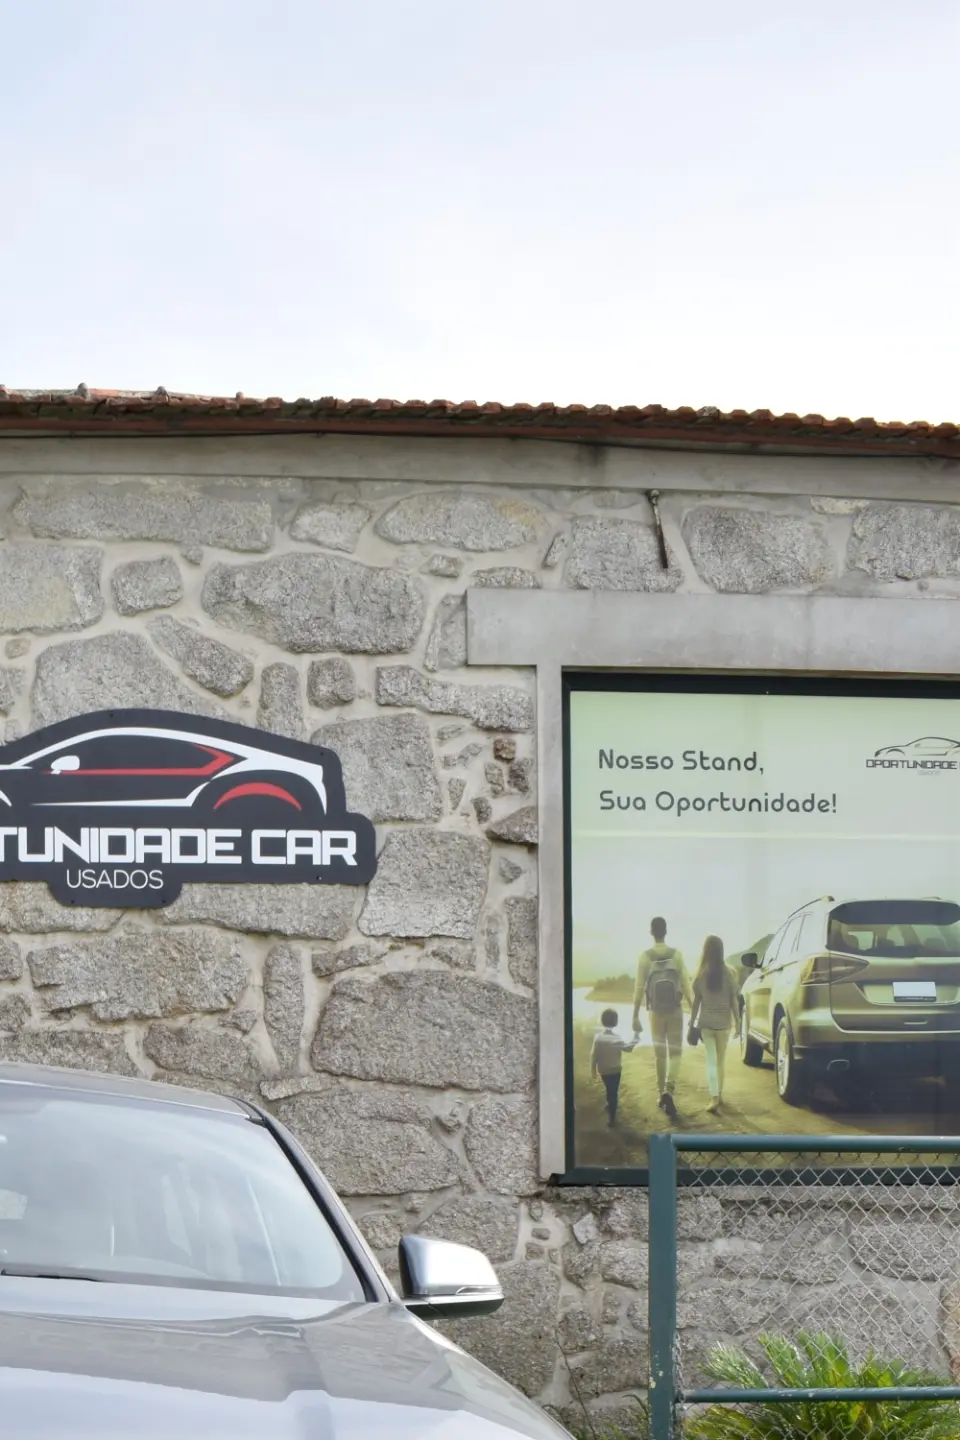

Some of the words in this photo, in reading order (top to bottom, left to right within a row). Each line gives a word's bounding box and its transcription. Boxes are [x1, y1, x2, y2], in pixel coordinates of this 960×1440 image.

[599, 749, 674, 770] Nosso
[682, 750, 764, 775] Stand,
[865, 759, 958, 770] OPORTUNIDADE
[599, 790, 646, 810] Sua
[655, 790, 837, 817] Oportunidade!
[251, 829, 358, 866] CAR
[66, 869, 164, 890] USADOS
